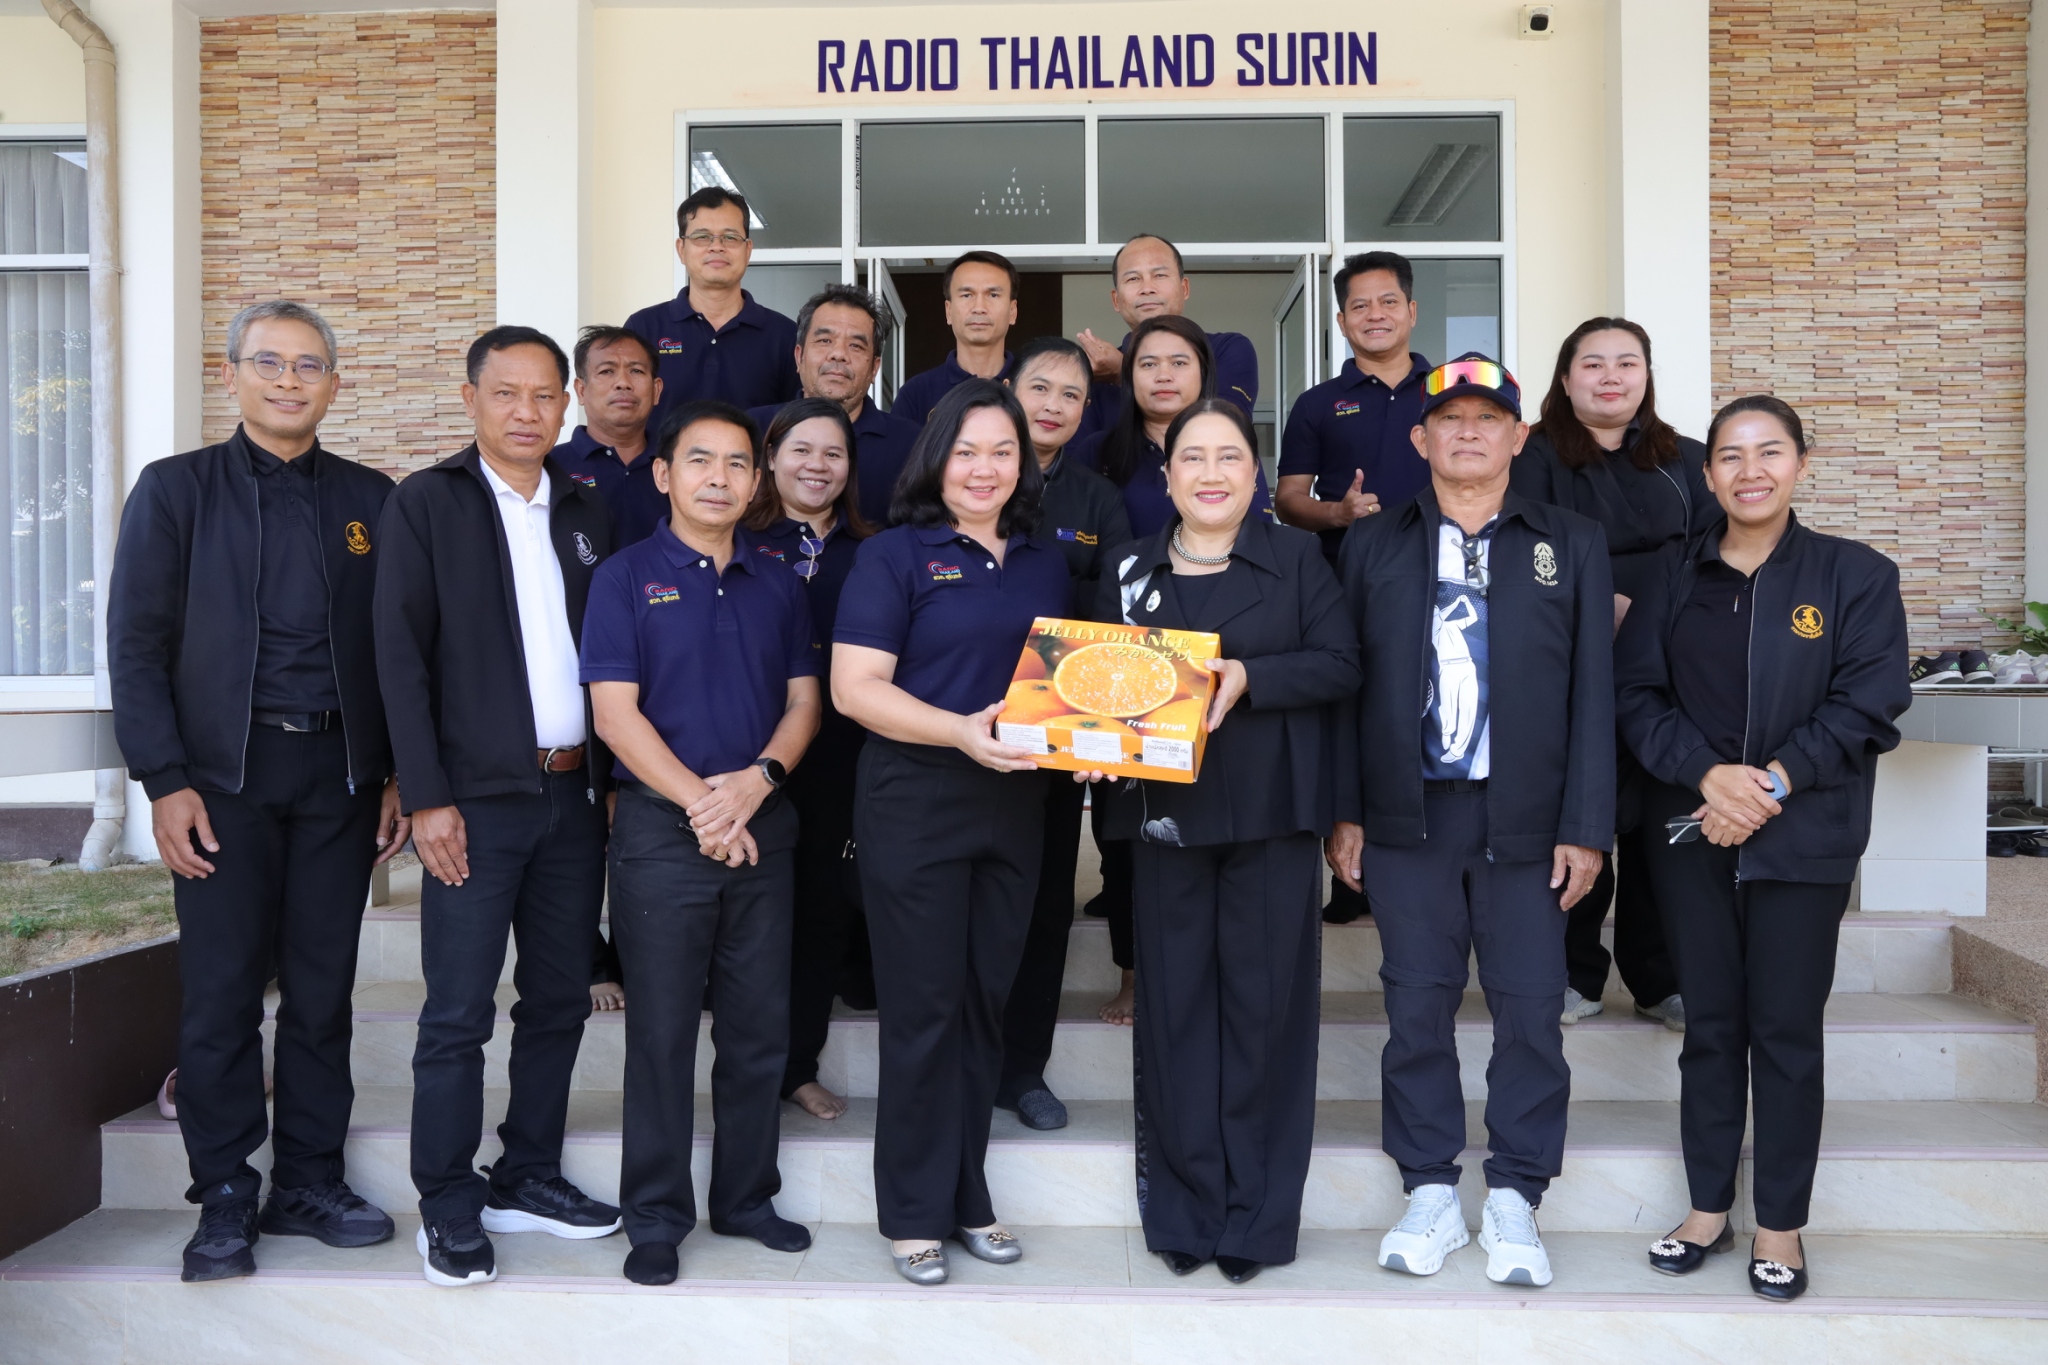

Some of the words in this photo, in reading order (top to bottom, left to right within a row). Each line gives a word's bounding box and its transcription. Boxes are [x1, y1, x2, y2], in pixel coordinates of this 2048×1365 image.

[818, 37, 958, 93] RADIO
[980, 33, 1215, 90] THAILAND
[1236, 31, 1377, 86] SURIN
[1039, 625, 1100, 641] JELLY
[1102, 631, 1191, 649] ORANGE
[1113, 648, 1205, 662] みかんゼリー
[1127, 719, 1157, 729] Fresh
[1160, 722, 1187, 732] Fruit
